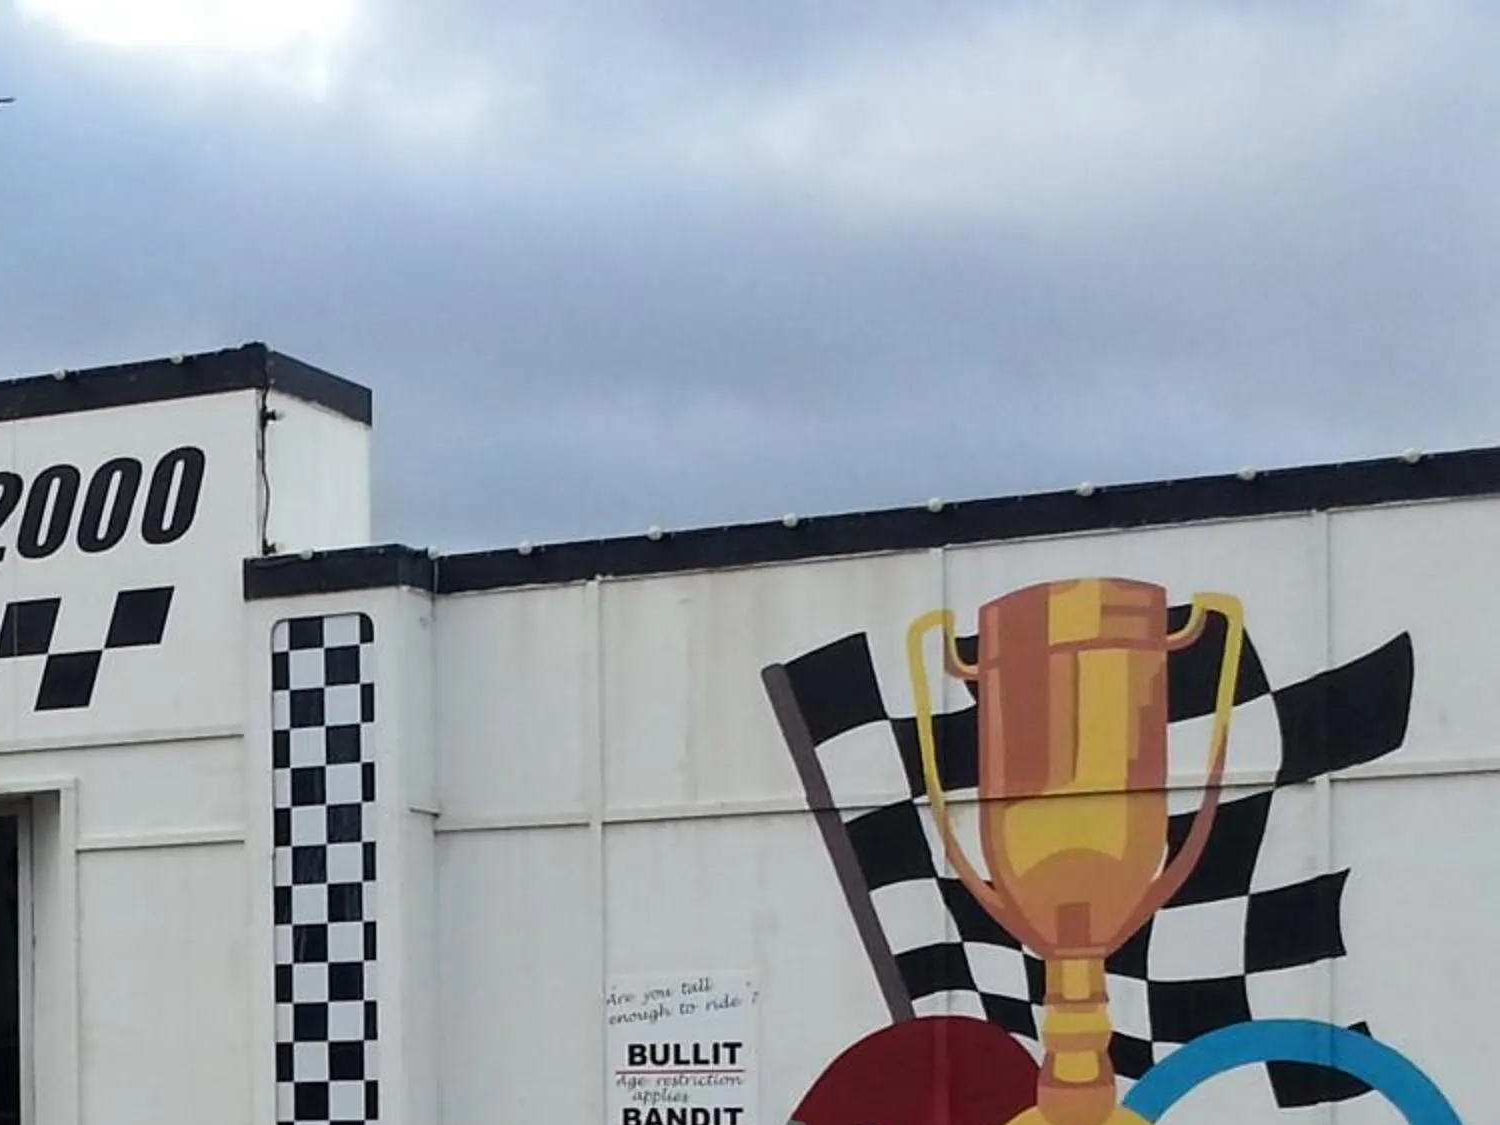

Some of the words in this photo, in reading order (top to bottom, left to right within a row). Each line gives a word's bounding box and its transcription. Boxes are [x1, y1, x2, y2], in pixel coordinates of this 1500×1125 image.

[681, 977, 711, 995] tall
[609, 1004, 671, 1024] enough
[679, 1003, 697, 1014] to
[706, 994, 741, 1011] ride
[628, 1042, 742, 1066] BULLIT
